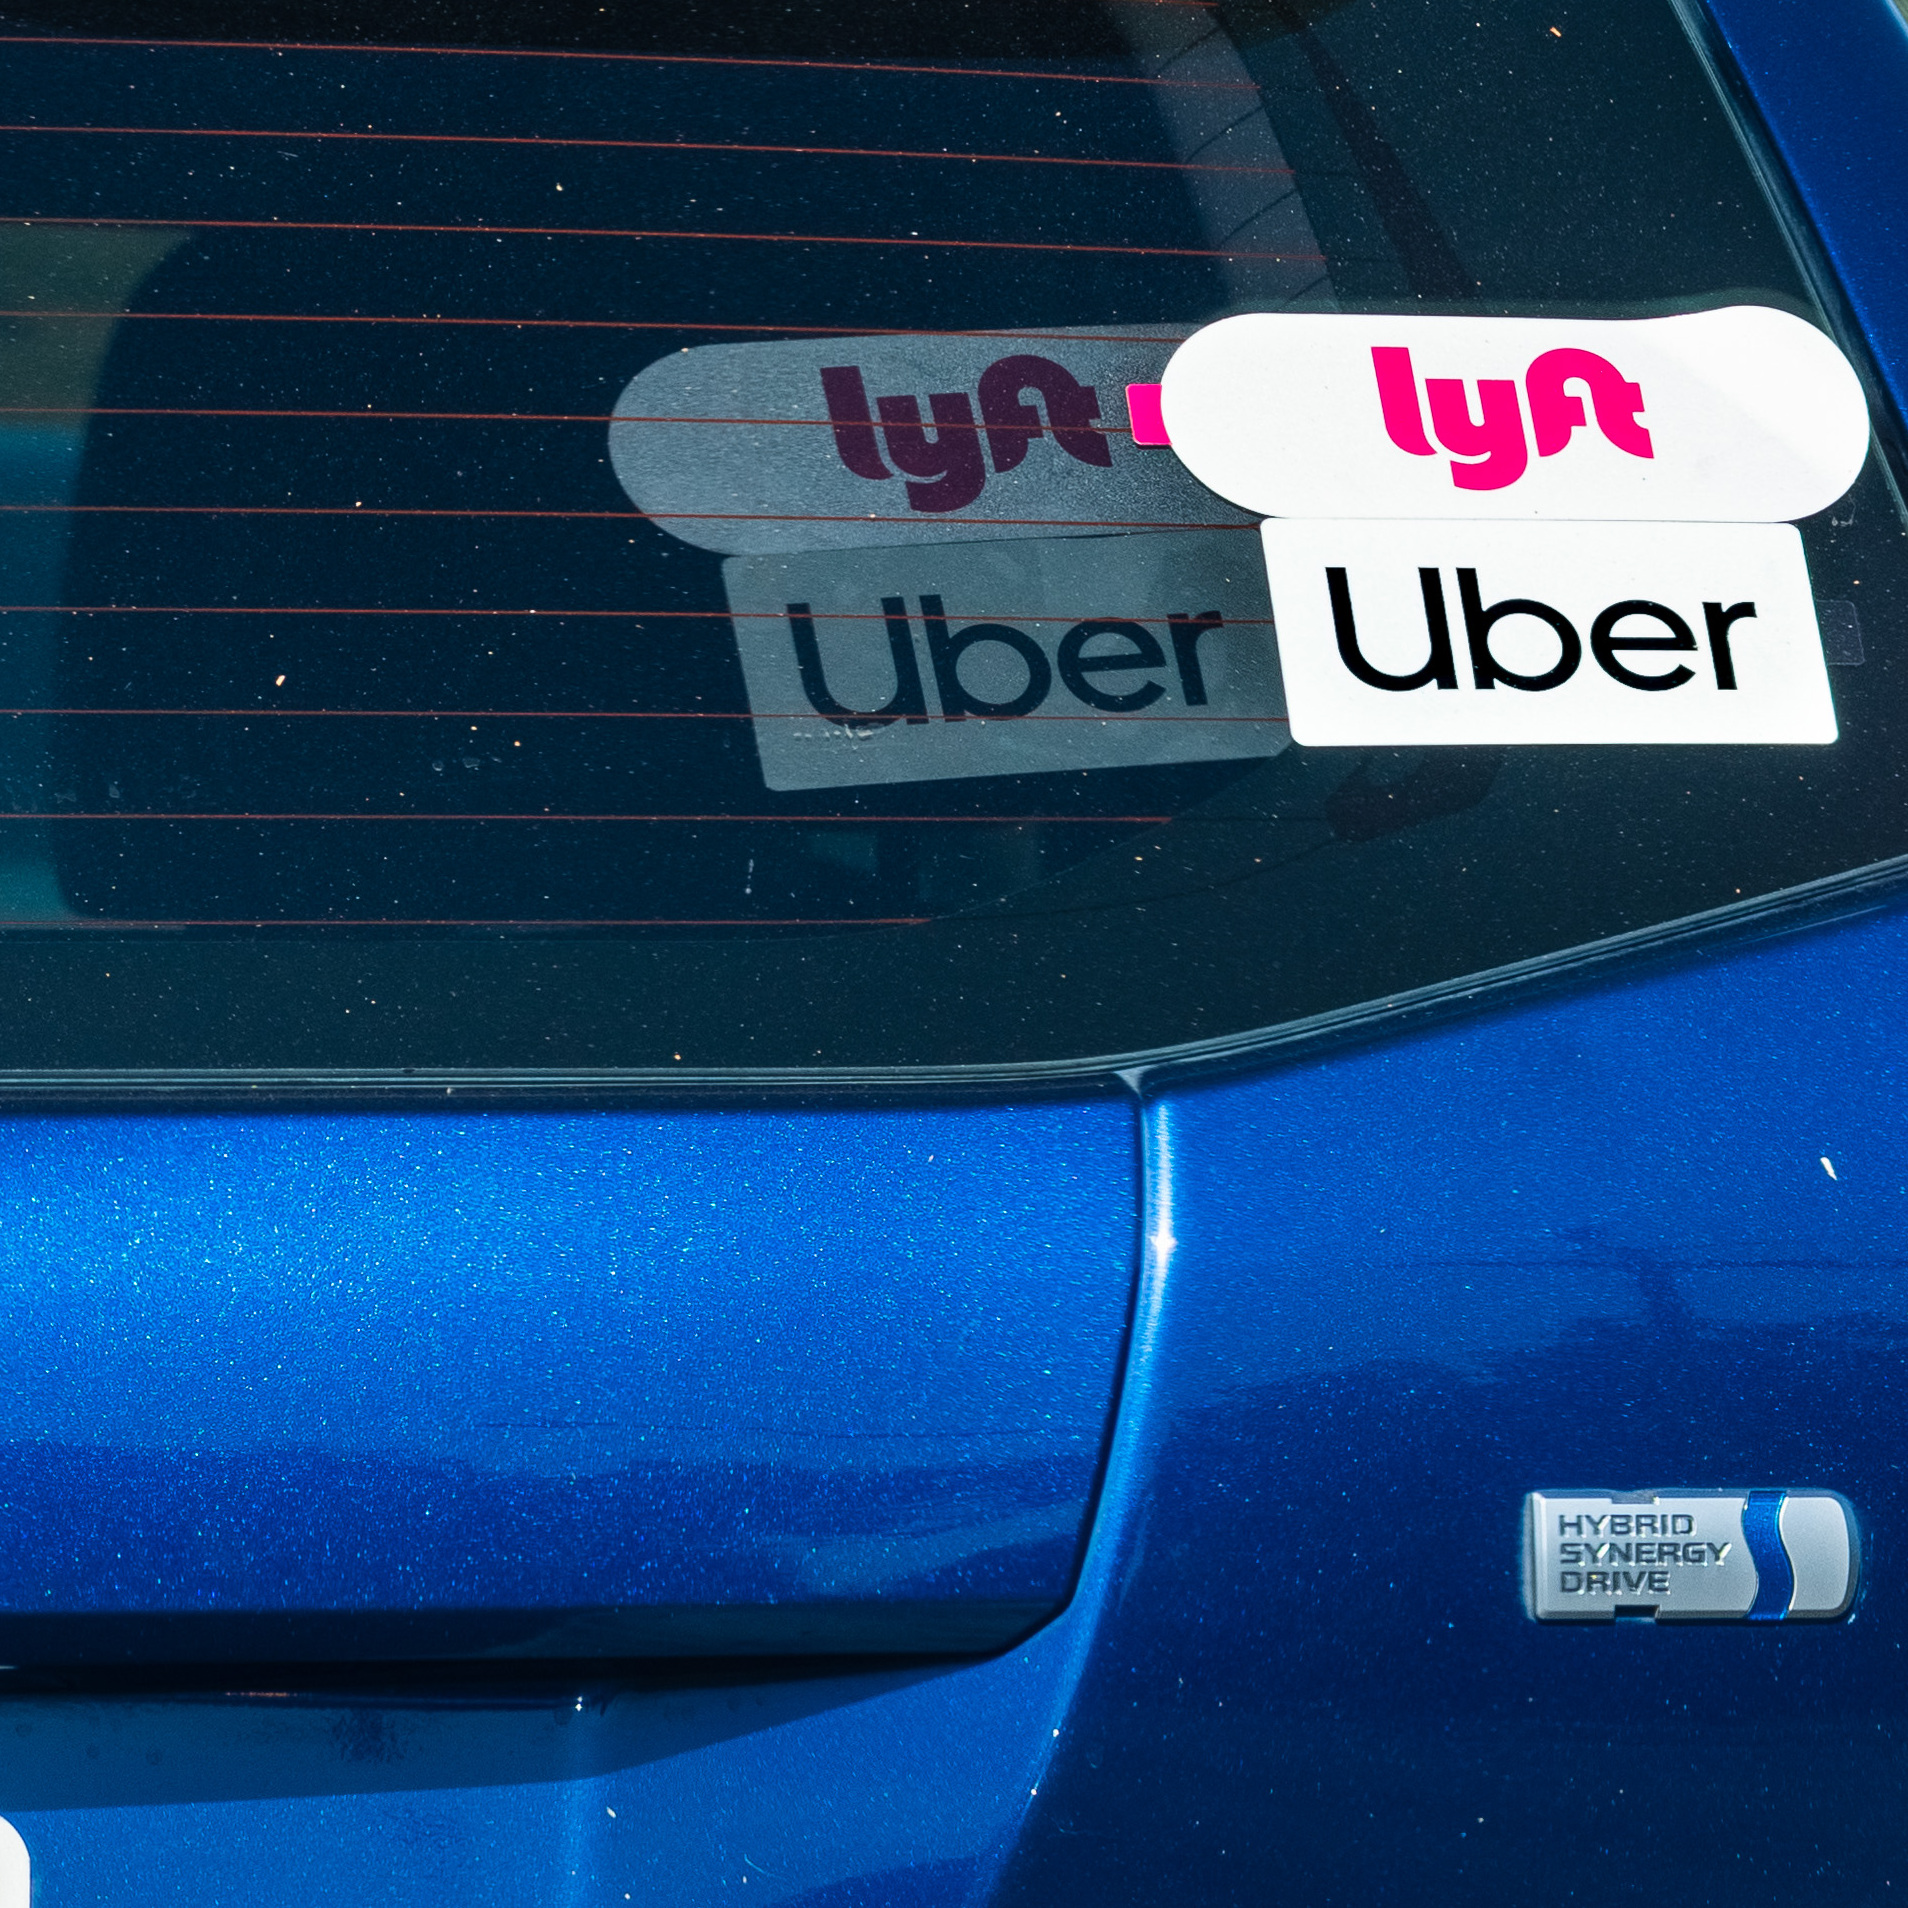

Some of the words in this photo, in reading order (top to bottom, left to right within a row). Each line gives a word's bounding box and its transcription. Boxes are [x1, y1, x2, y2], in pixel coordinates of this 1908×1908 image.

[819, 354, 1112, 513] lyft
[1371, 346, 1654, 491] lyft
[786, 594, 1223, 727] Uber
[1325, 566, 1757, 692] Uber
[1558, 1514, 1697, 1537] HYBRID
[1559, 1542, 1732, 1566] SYNERGY
[1559, 1571, 1672, 1595] DRIVE
